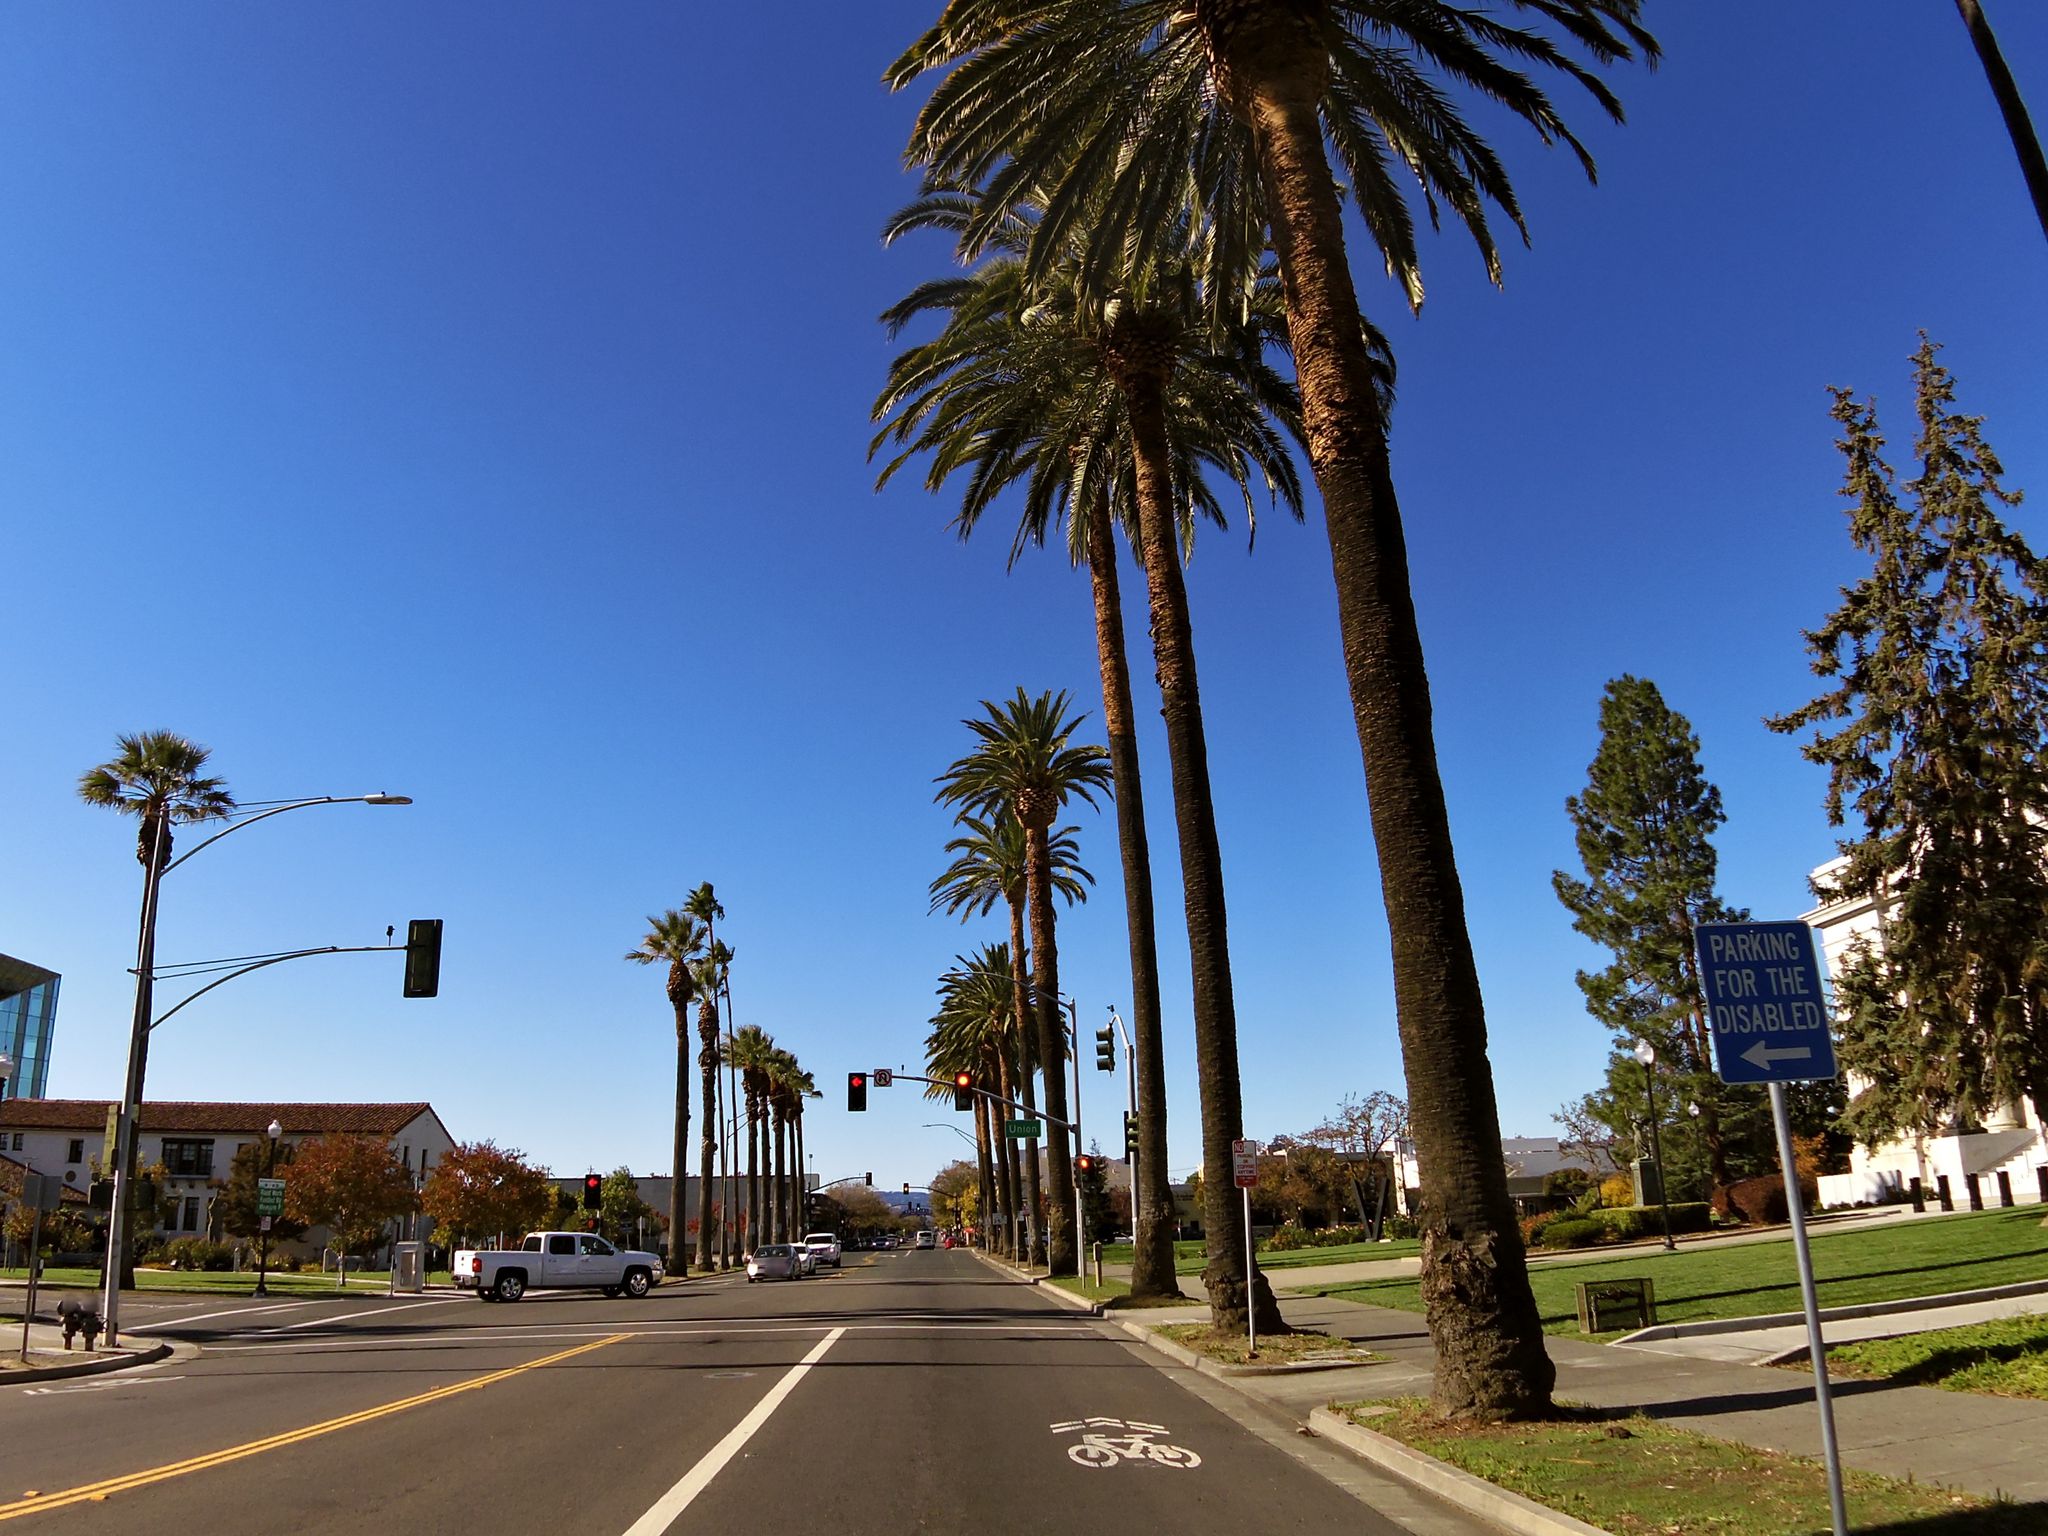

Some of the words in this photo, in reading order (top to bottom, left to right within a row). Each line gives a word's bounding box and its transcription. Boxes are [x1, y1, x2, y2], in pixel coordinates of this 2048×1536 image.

[1709, 932, 1800, 963] PARKING
[1714, 969, 1758, 998] FOR
[1766, 966, 1809, 996] THE
[1715, 1001, 1821, 1034] DISABLED
[1009, 1125, 1037, 1134] Union
[1234, 1142, 1244, 1152] NO
